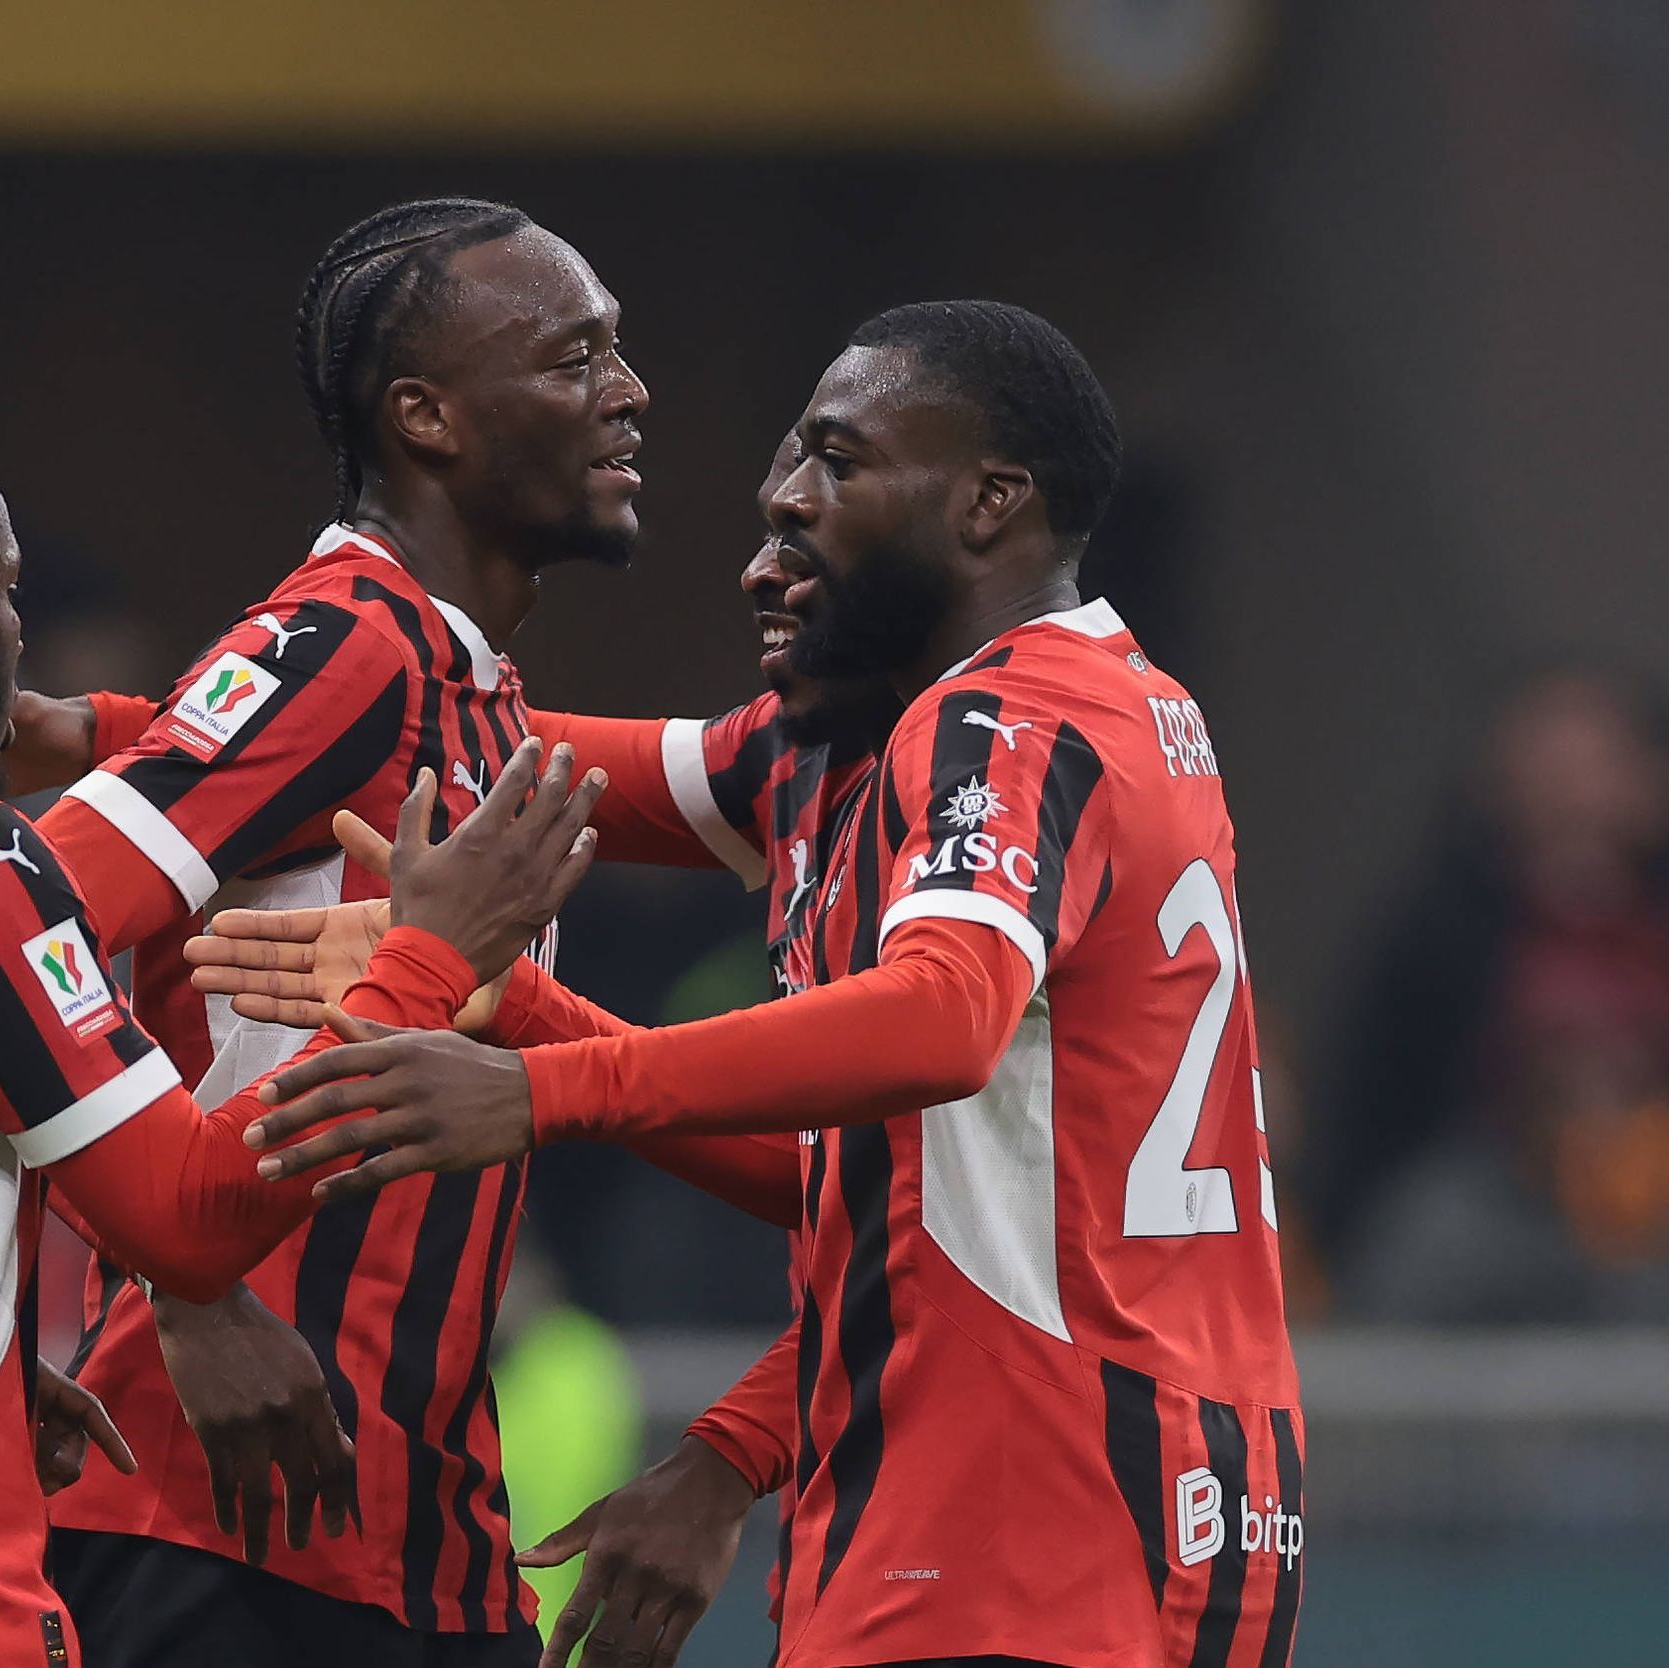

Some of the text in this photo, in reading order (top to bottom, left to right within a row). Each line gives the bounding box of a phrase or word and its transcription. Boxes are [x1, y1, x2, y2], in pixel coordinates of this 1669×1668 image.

[181, 701, 231, 737] COPPA ITALIA
[901, 831, 1042, 894] MSC
[884, 1569, 941, 1581] ULTRAWEAVE
